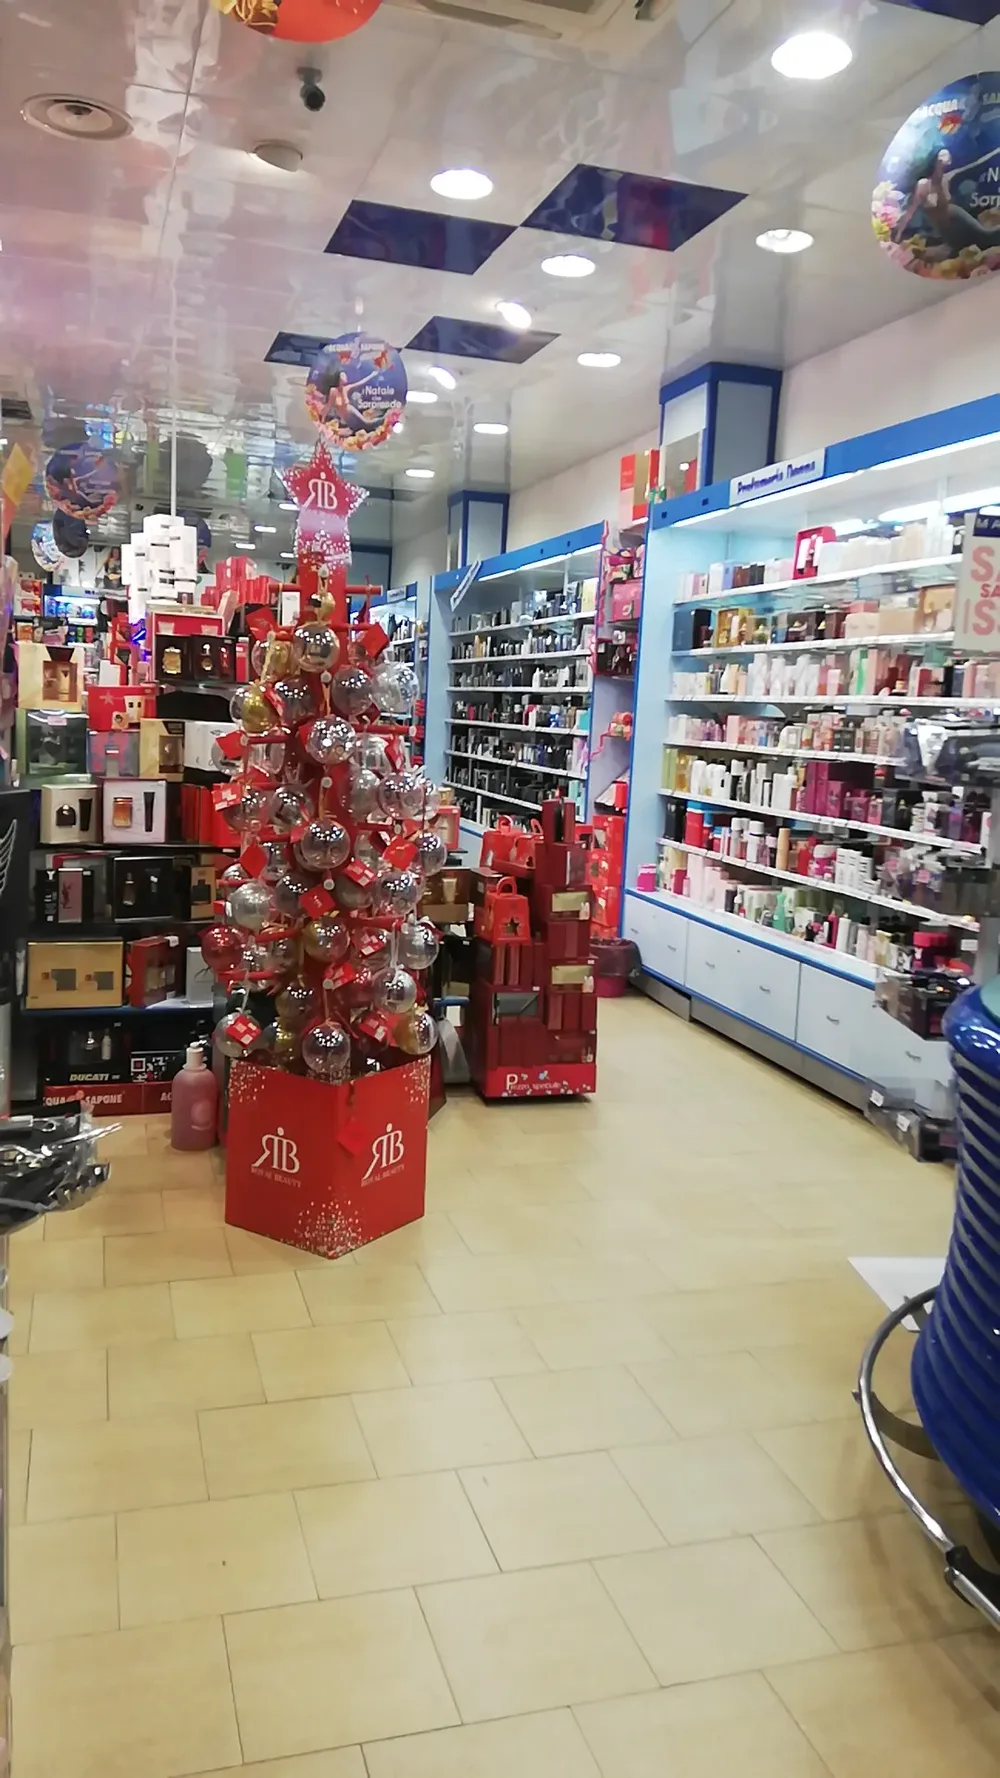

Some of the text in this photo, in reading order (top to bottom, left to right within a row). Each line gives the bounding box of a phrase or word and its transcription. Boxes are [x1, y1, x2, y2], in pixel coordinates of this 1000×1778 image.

[365, 385, 396, 396] Natale
[357, 399, 403, 410] Sorprende
[69, 1073, 109, 1082] DUCATI
[84, 1094, 122, 1105] SAPONE
